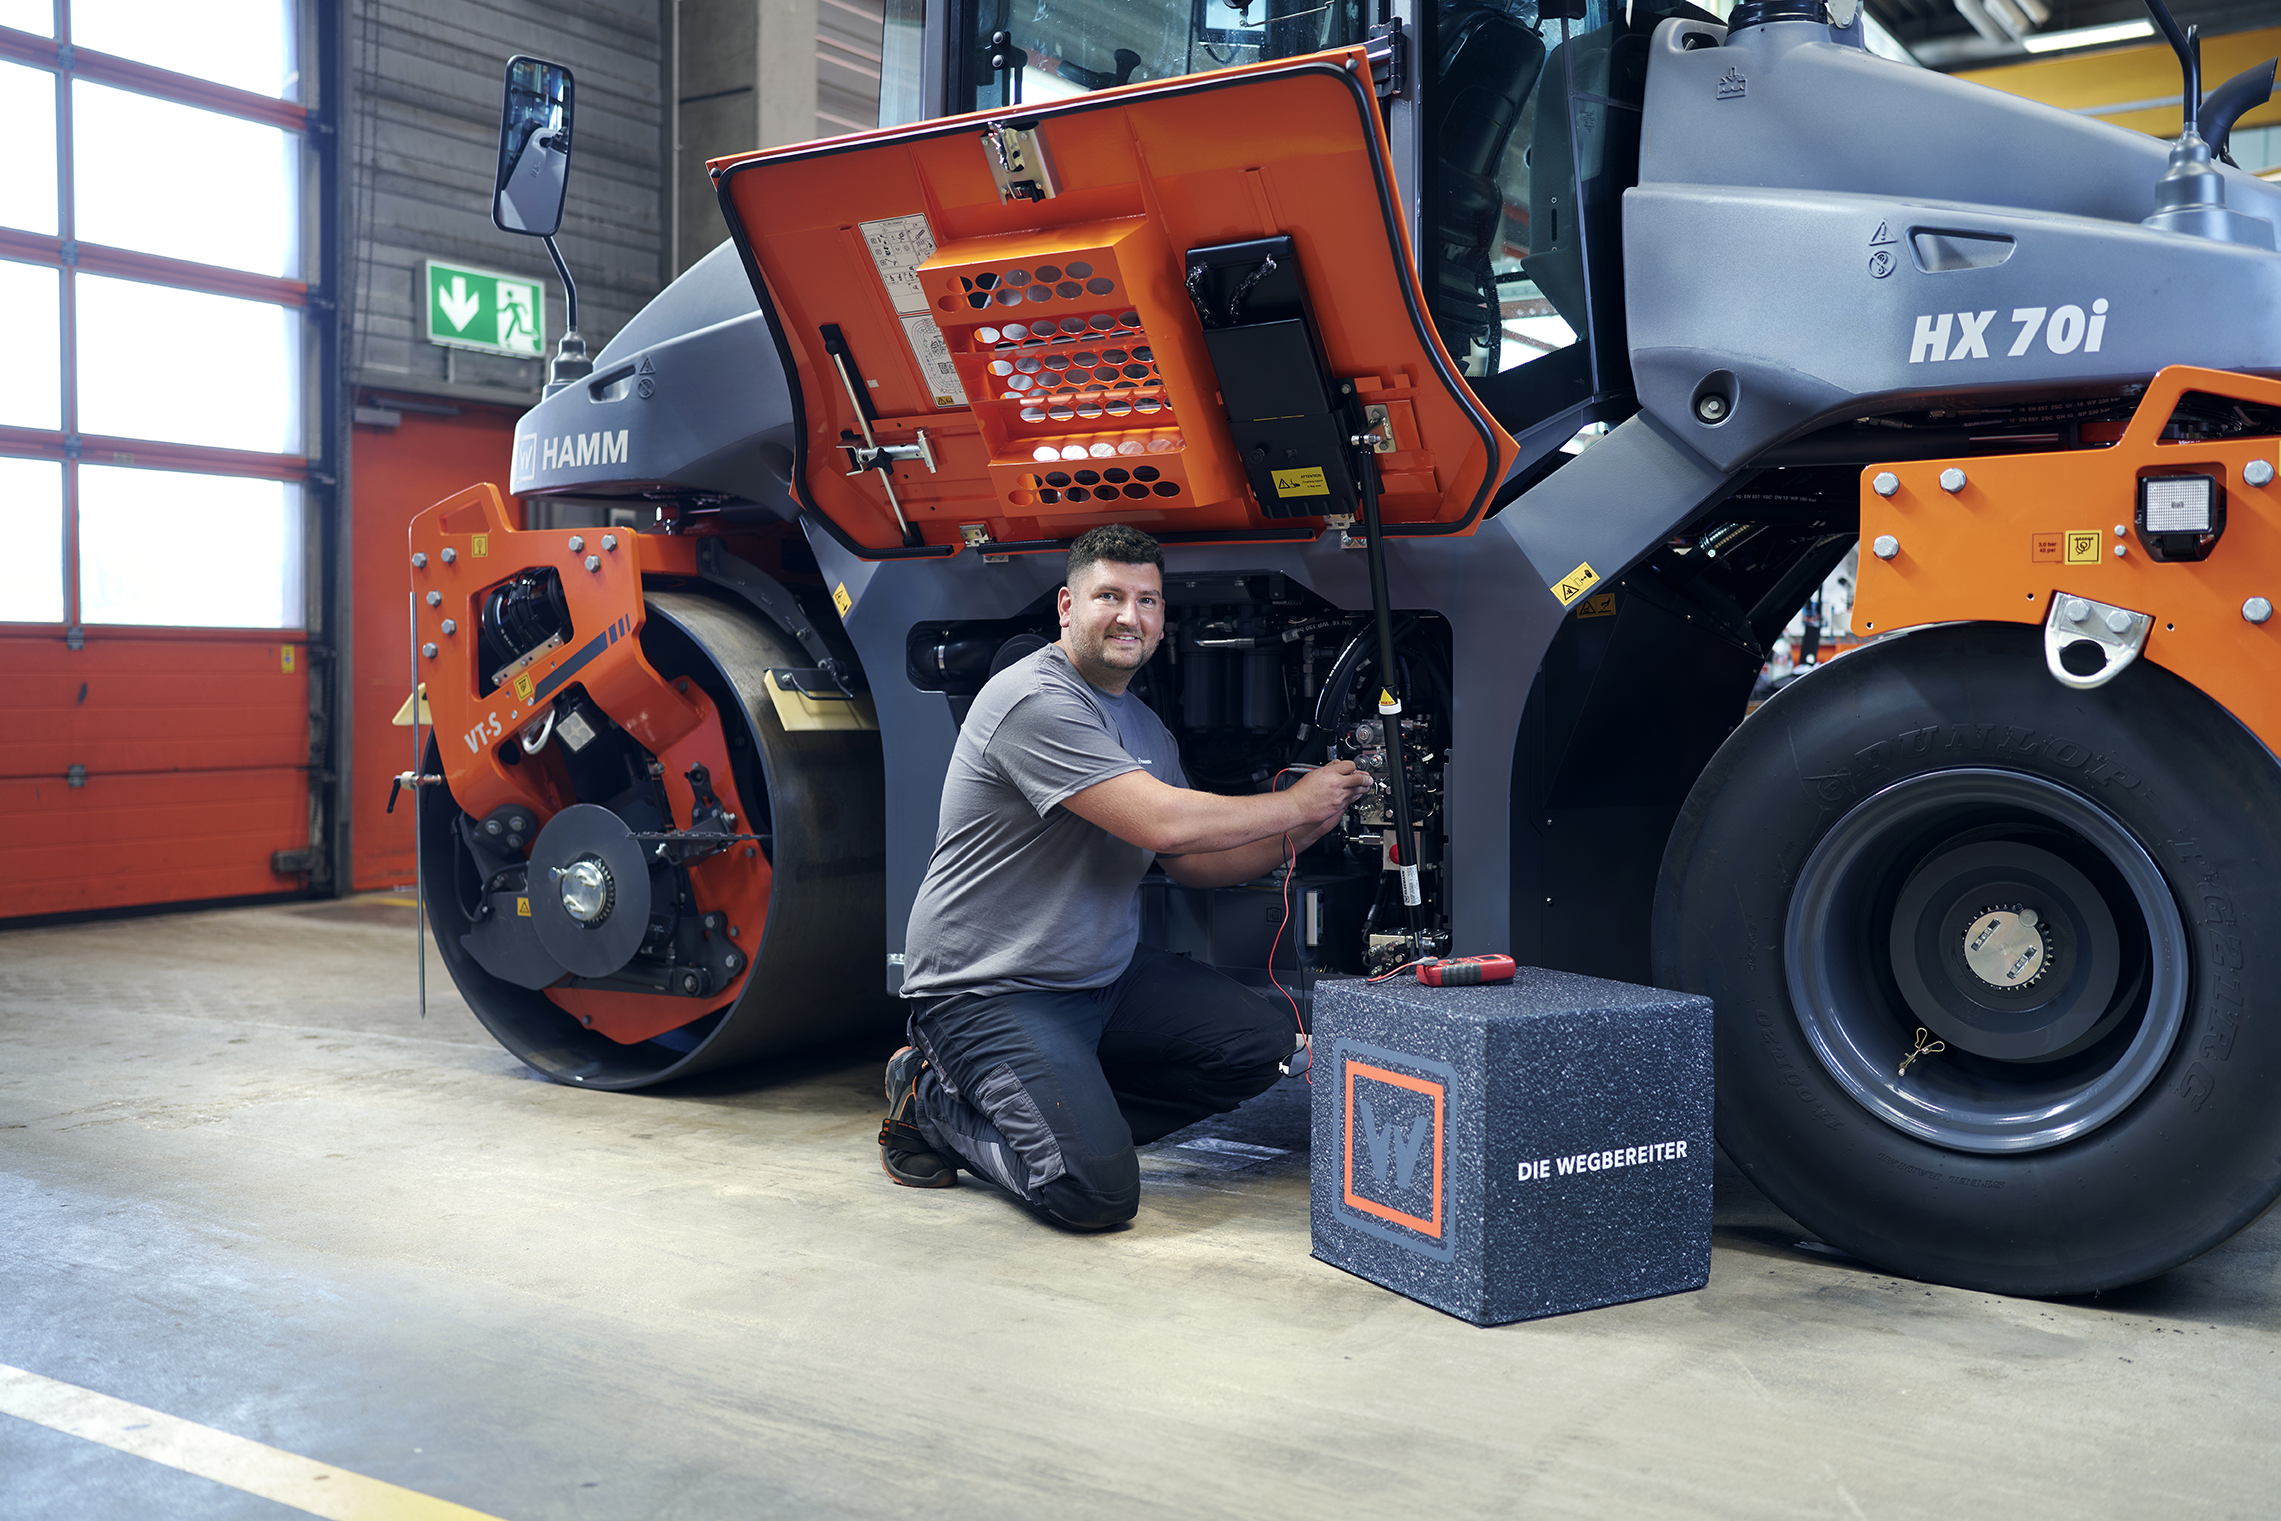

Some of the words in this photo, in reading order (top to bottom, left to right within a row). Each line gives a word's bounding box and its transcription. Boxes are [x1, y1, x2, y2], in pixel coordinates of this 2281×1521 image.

[1909, 310, 1998, 363] HX
[2007, 298, 2109, 357] 70i
[542, 430, 629, 471] HAMM
[464, 711, 502, 754] VT-S
[1854, 723, 2142, 790] DUNLOP
[1518, 1159, 1551, 1181] DIE
[1556, 1140, 1688, 1176] WEGBEREITER
